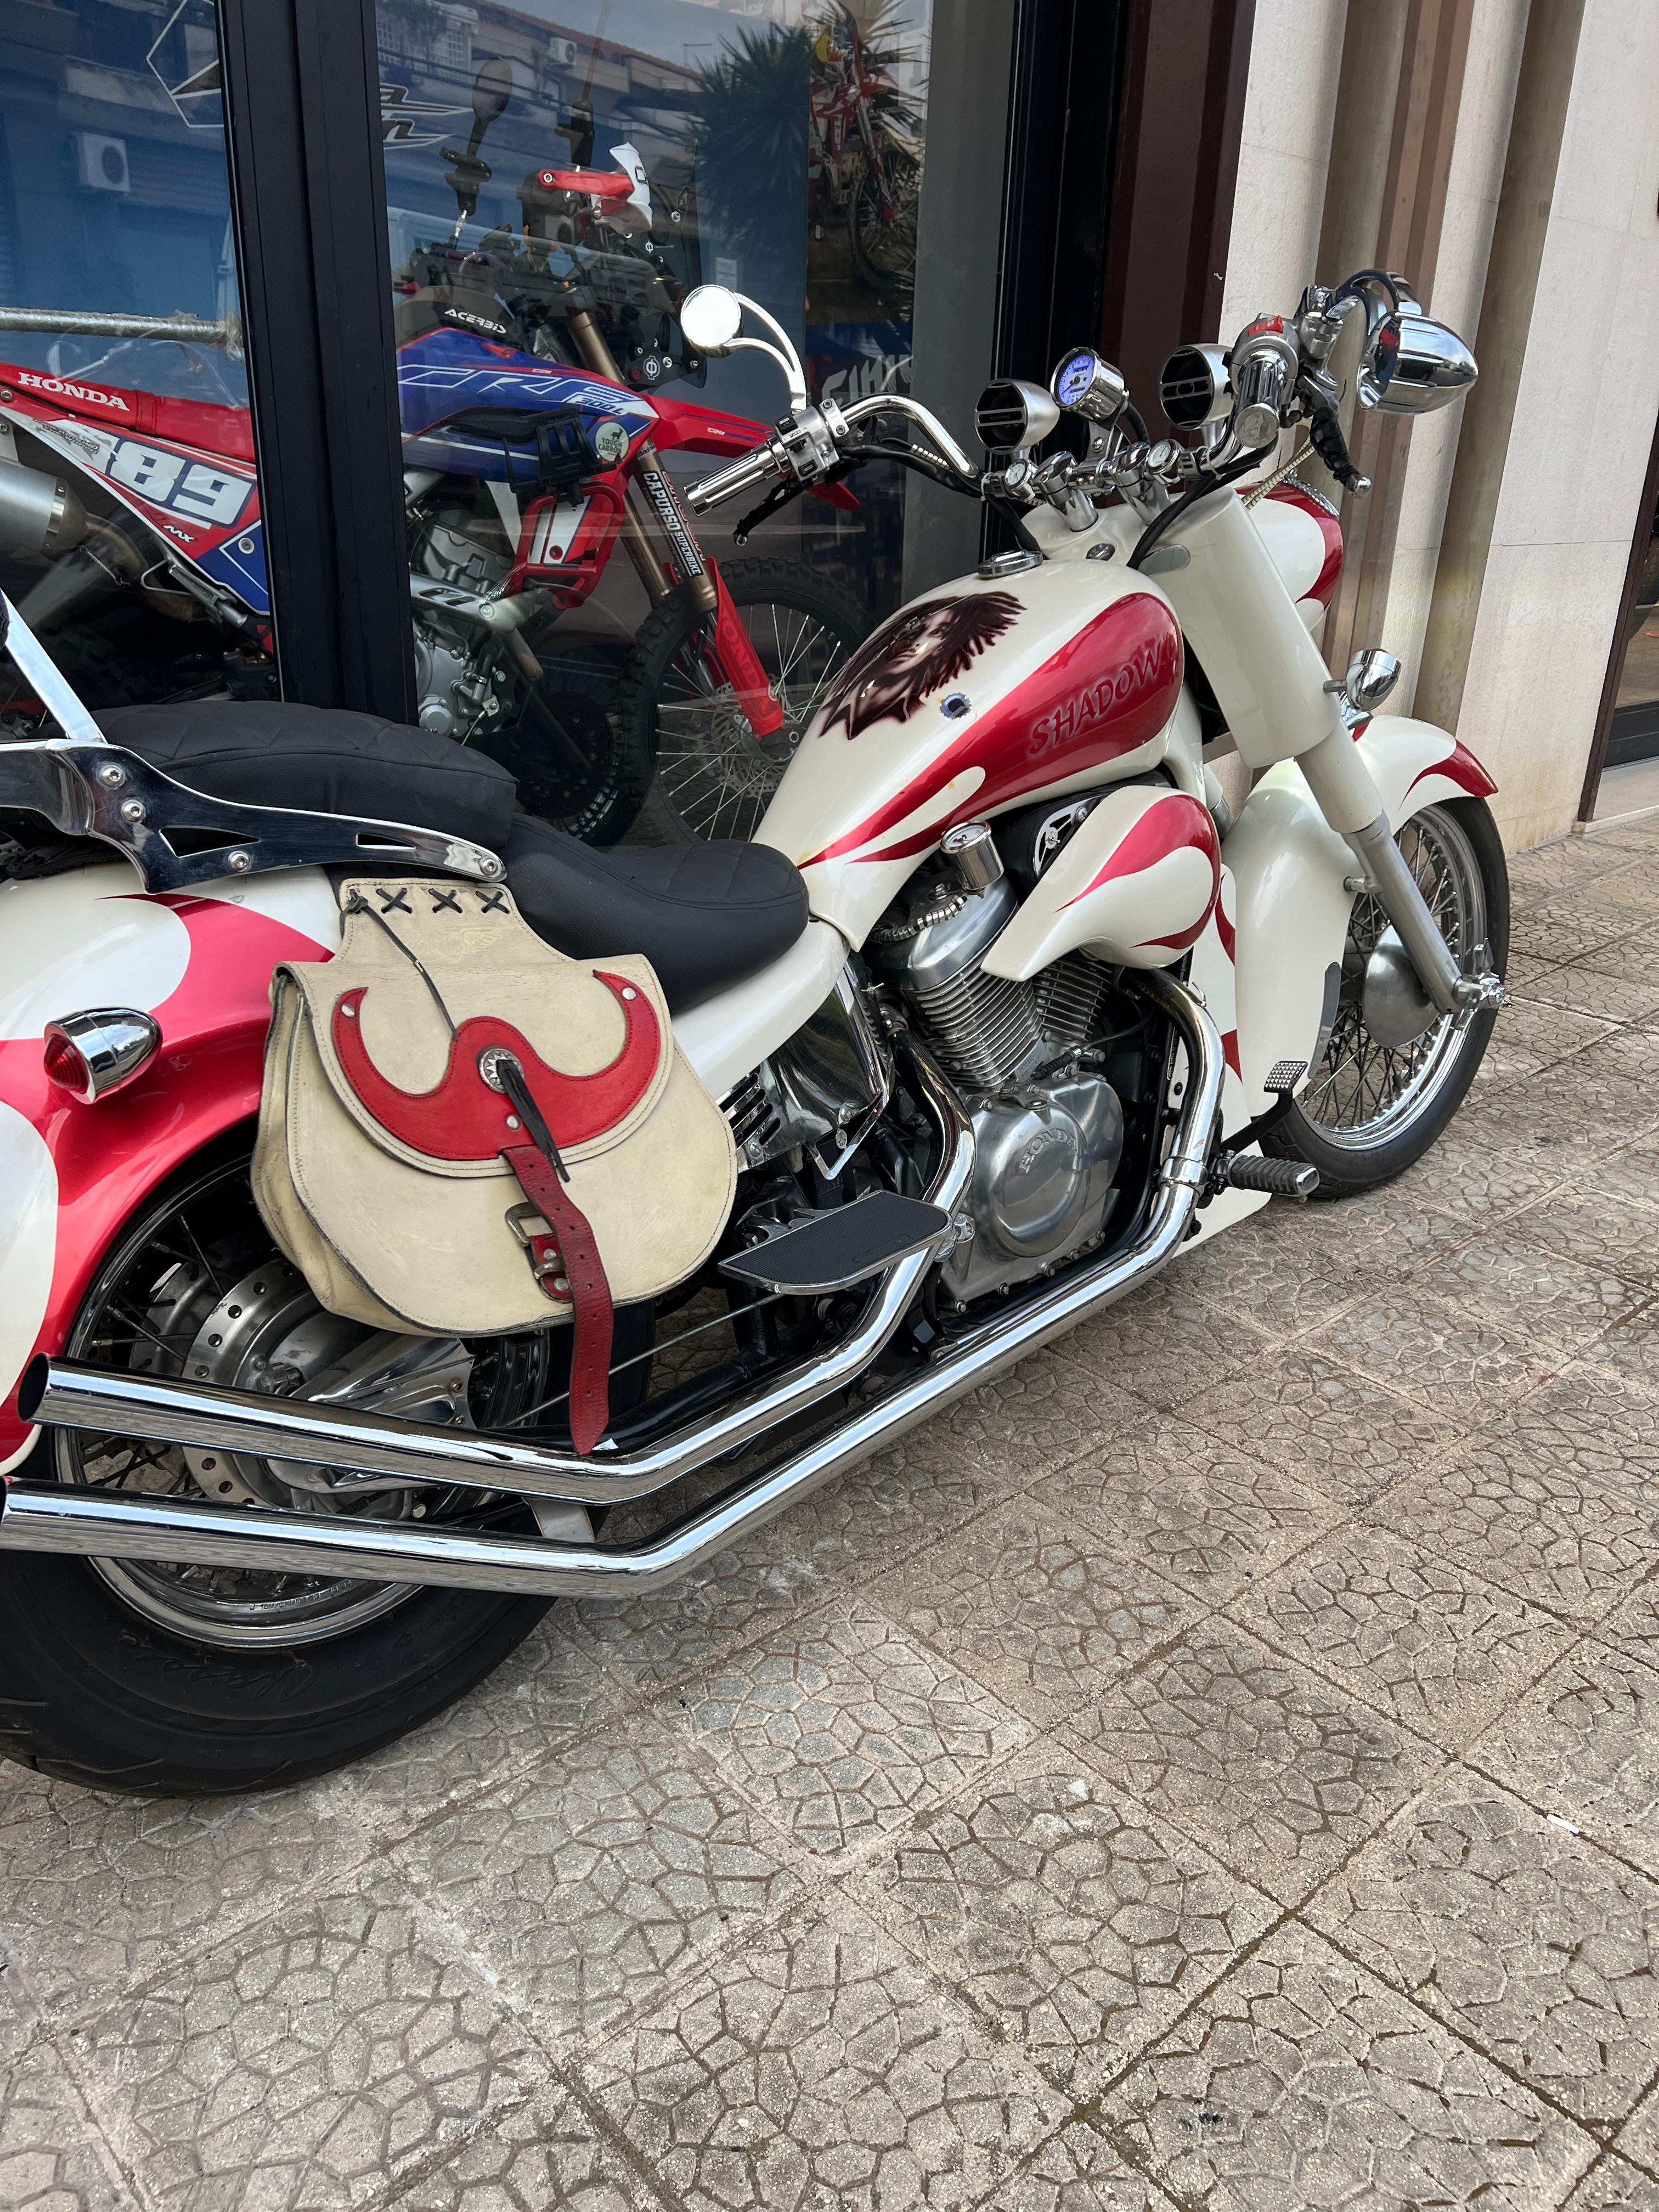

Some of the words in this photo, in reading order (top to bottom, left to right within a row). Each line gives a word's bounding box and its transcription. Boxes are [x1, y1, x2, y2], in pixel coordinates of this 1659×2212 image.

[444, 308, 507, 334] ACERBIS
[18, 372, 130, 411] HONDA
[577, 397, 624, 415] 300L
[602, 438, 622, 448] TOUGH
[109, 440, 253, 526] 89
[643, 472, 681, 531] CAPURSO
[674, 531, 702, 575] SUPERBIKE
[1029, 639, 1164, 755] SHADOW
[1019, 1127, 1077, 1174] HONDA
